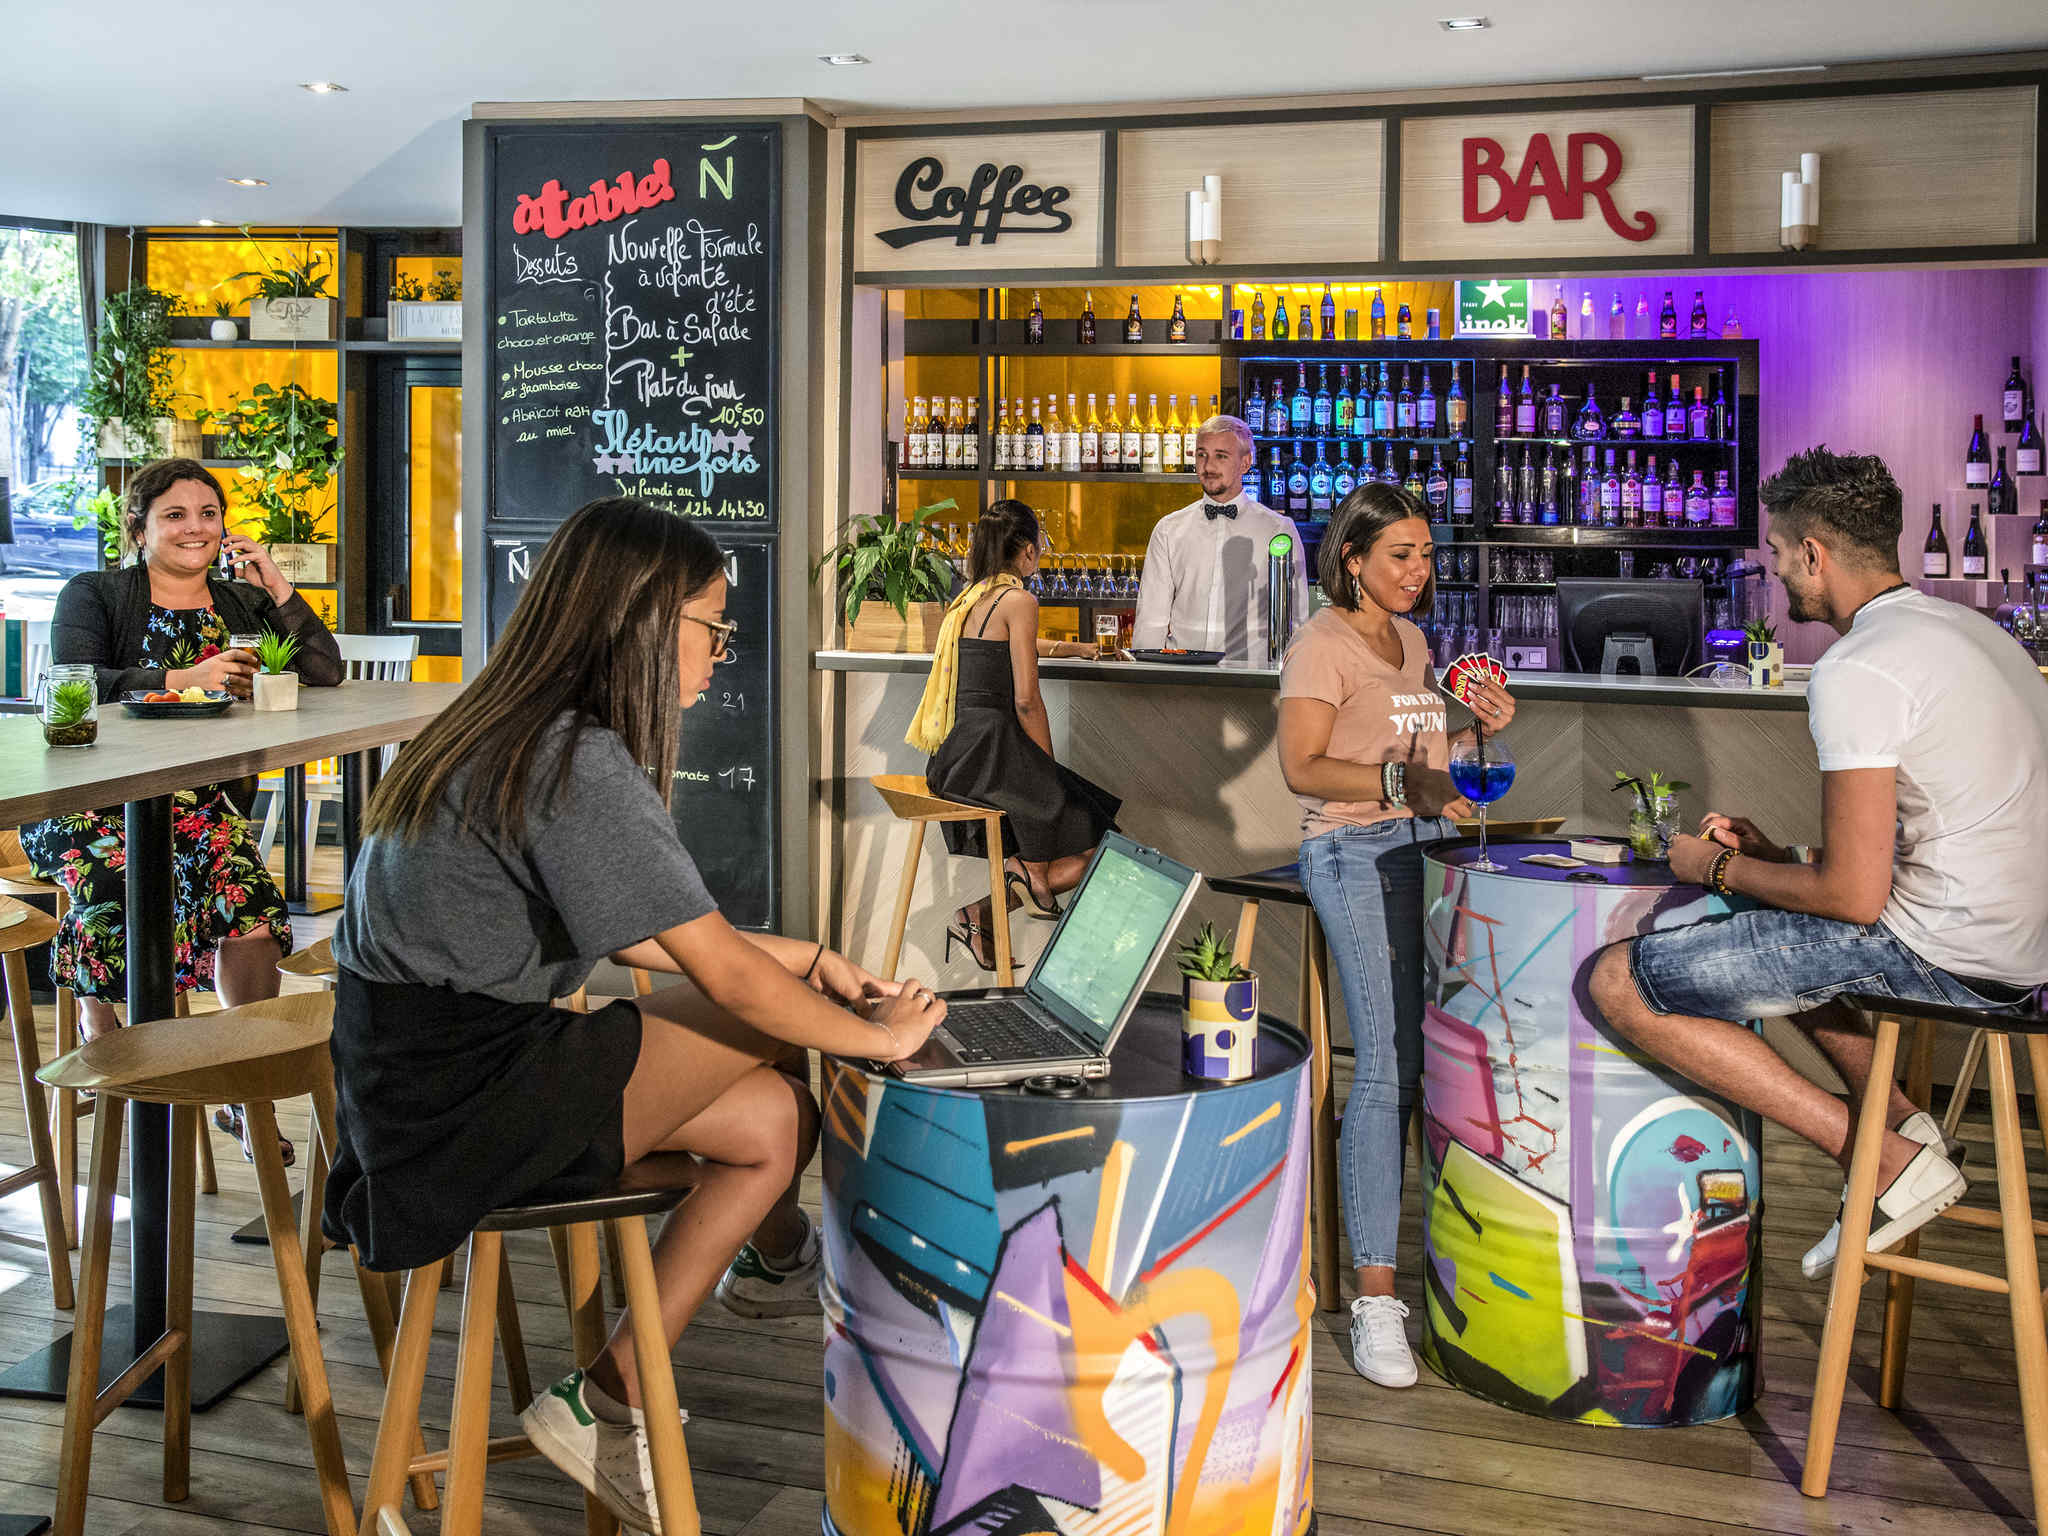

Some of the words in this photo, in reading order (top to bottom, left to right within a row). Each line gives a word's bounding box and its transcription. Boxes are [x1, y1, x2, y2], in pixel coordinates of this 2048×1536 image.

[1463, 133, 1657, 242] BAR
[874, 156, 1072, 249] Coffee
[638, 268, 652, 287] à
[706, 283, 757, 314] d'été
[666, 317, 679, 341] à
[682, 313, 752, 346] Salade
[497, 336, 534, 349] choco
[513, 360, 565, 379] Mousse
[567, 360, 604, 371] choco
[501, 387, 518, 400] et
[519, 379, 581, 399] framboise
[676, 371, 700, 397] du
[516, 432, 538, 442] au
[676, 483, 695, 498] au
[722, 692, 745, 712] 21
[1389, 711, 1447, 735] YOUN
[718, 765, 756, 793] 17
